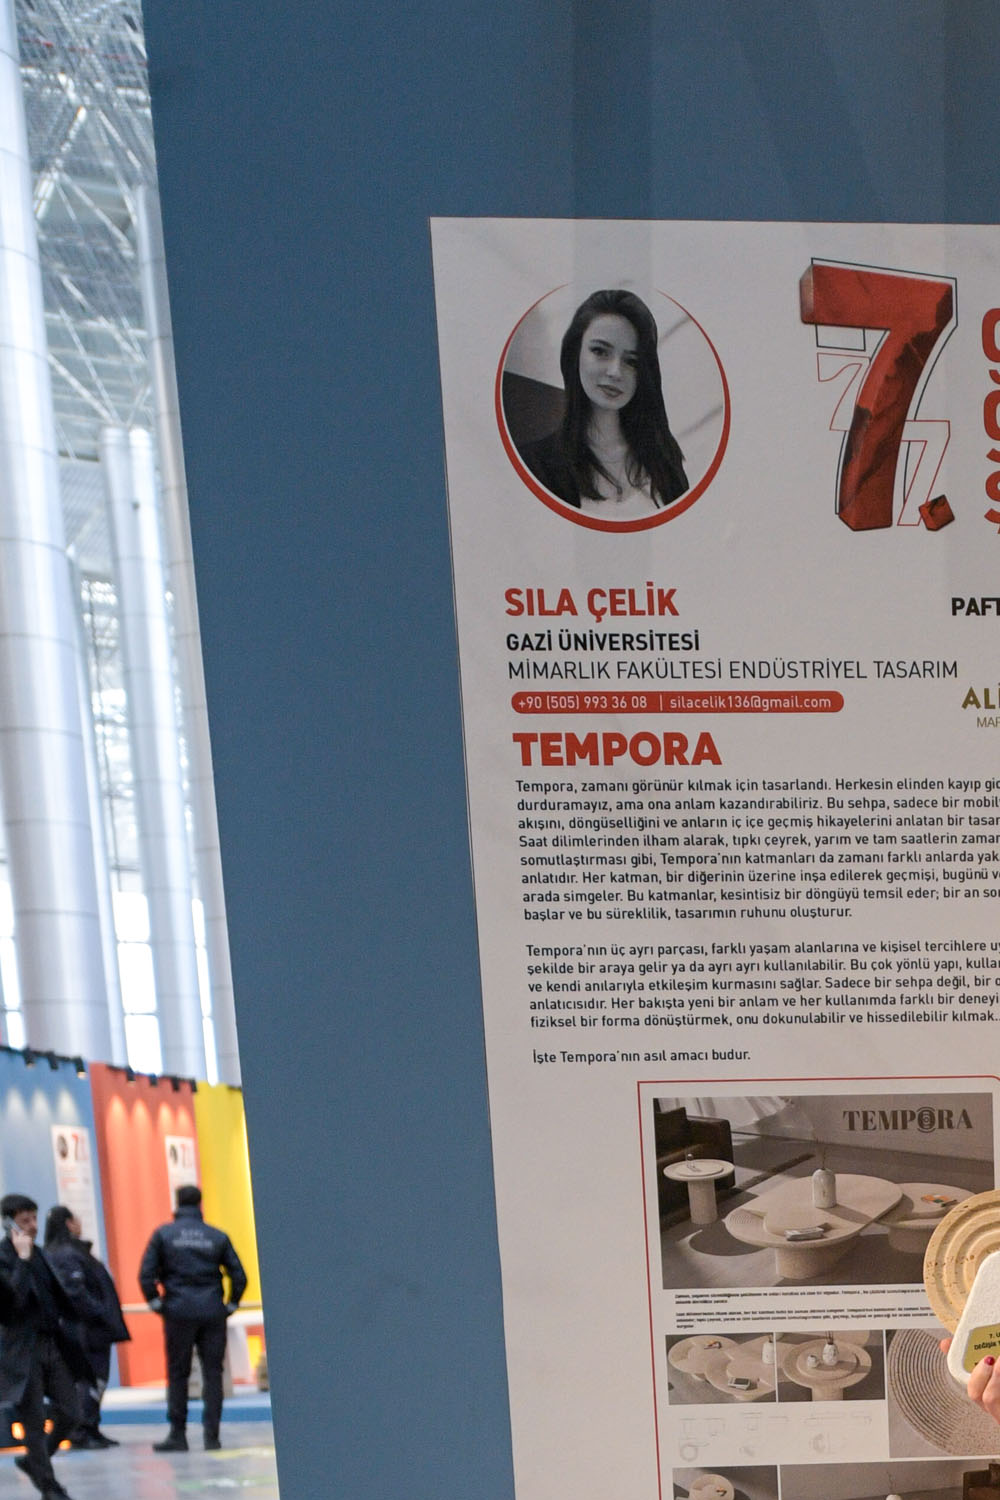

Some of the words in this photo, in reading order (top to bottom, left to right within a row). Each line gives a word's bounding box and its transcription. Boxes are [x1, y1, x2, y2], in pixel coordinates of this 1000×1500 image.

[505, 588, 578, 616] SILA
[587, 581, 680, 623] ÇELİK
[506, 629, 553, 652] GAZİ
[558, 629, 700, 652] ÜNİVERSİTESİ
[508, 658, 611, 680] MİMARLIK
[617, 658, 722, 680] FAKÜLTESİ
[730, 657, 868, 680] ENDÜSTRİYEL
[873, 660, 958, 679] TASARIM
[518, 696, 542, 709] +90
[547, 695, 580, 710] (505)
[584, 695, 608, 709] 993
[612, 695, 628, 709] 36
[631, 695, 648, 708] 08
[670, 694, 831, 711] silacelik136@gmail.com
[512, 732, 722, 766] TEMPORA
[515, 780, 577, 795] Tempora,
[581, 783, 628, 792] zamanı
[632, 779, 684, 795] görünür
[688, 779, 732, 791] kılmak
[736, 779, 758, 792] için
[762, 779, 831, 790] tasarlandı.
[836, 778, 893, 790] Herkesin
[897, 778, 944, 790] elinden
[948, 778, 981, 792] kayıp
[517, 799, 612, 813] durduramayız,
[616, 801, 643, 810] ama
[648, 801, 671, 810] ona
[675, 798, 715, 810] anlam
[720, 797, 822, 809] kazandırabiliriz.
[827, 797, 843, 808] Bu
[848, 797, 889, 811] sehpa,
[894, 796, 938, 808] sadece
[942, 796, 960, 808] bir
[518, 817, 564, 831] akışını,
[569, 816, 660, 831] döngüselliğini
[663, 819, 677, 828] ve
[682, 816, 727, 828] anların
[732, 816, 741, 829] iç
[746, 816, 763, 828] içe
[768, 815, 813, 830] geçmiş
[817, 815, 892, 830] hikayelerini
[896, 815, 943, 826] anlatan
[947, 814, 965, 826] bir
[520, 854, 626, 867] somutlaştırması
[631, 853, 656, 868] gibi,
[745, 852, 815, 864] katmanları
[819, 852, 834, 863] da
[838, 854, 883, 863] zamanı
[888, 851, 921, 863] farklı
[925, 851, 974, 862] anlarda
[524, 908, 565, 922] başlar
[568, 911, 582, 920] ve
[587, 908, 602, 919] bu
[606, 907, 671, 920] süreklilik,
[675, 908, 736, 918] tasarımın
[741, 906, 786, 918] ruhunu
[790, 906, 852, 919] oluşturur.
[611, 944, 625, 957] üç
[629, 946, 653, 958] ayrı
[658, 946, 708, 958] parçası,
[712, 942, 746, 954] farklı
[749, 945, 790, 957] yaşam
[795, 941, 859, 953] alanlarına
[862, 944, 876, 952] ve
[881, 940, 921, 954] kişisel
[925, 940, 986, 952] tercihlere
[531, 1016, 576, 1028] fiziksel
[580, 1015, 598, 1027] bir
[602, 1015, 640, 1026] forma
[644, 1013, 732, 1027] dönüştürmek,
[736, 1016, 758, 1024] onu
[763, 1012, 846, 1024] dokunulabilir
[849, 1015, 863, 1023] ve
[867, 1011, 948, 1023] hissedilebilir
[533, 1049, 556, 1064] İşte
[644, 1050, 667, 1061] asıl
[670, 1052, 708, 1061] amacı
[712, 1049, 750, 1060] budur.
